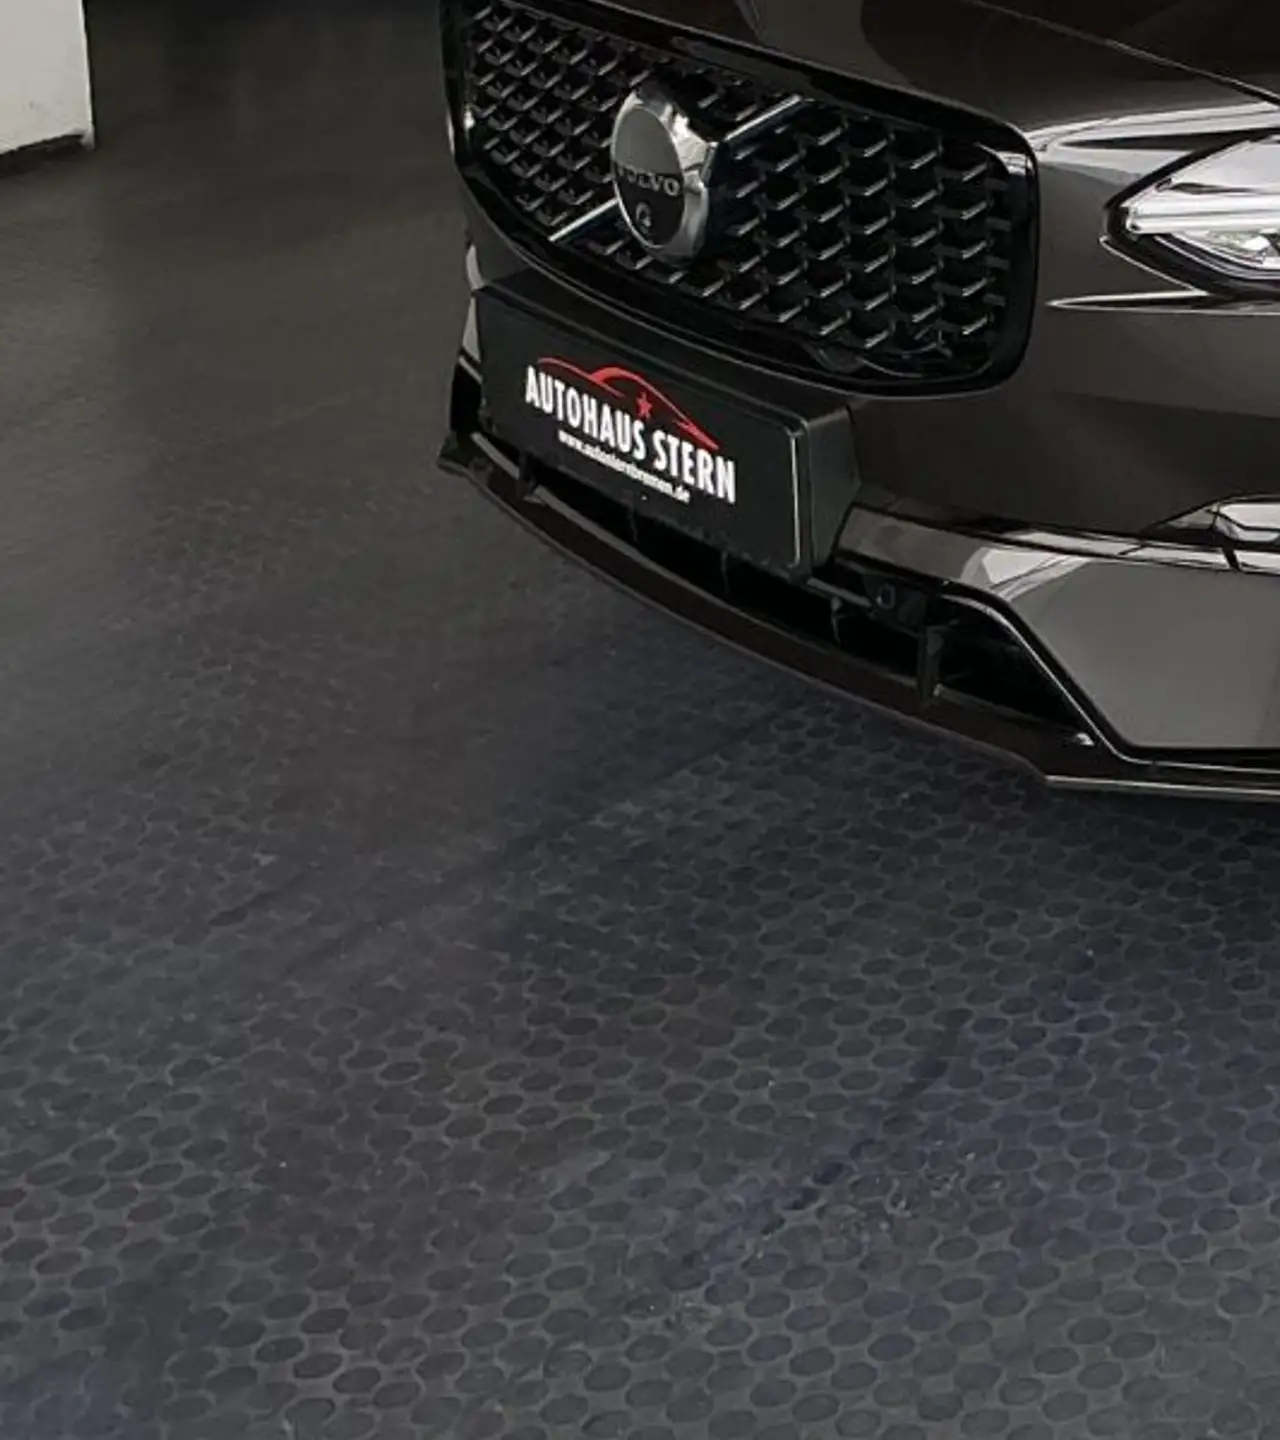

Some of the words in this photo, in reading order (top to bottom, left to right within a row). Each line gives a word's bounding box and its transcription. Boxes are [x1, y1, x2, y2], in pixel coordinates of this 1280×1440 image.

[617, 162, 681, 197] VOLVO
[525, 365, 647, 460] AUTOHAUS
[652, 429, 736, 504] STERN
